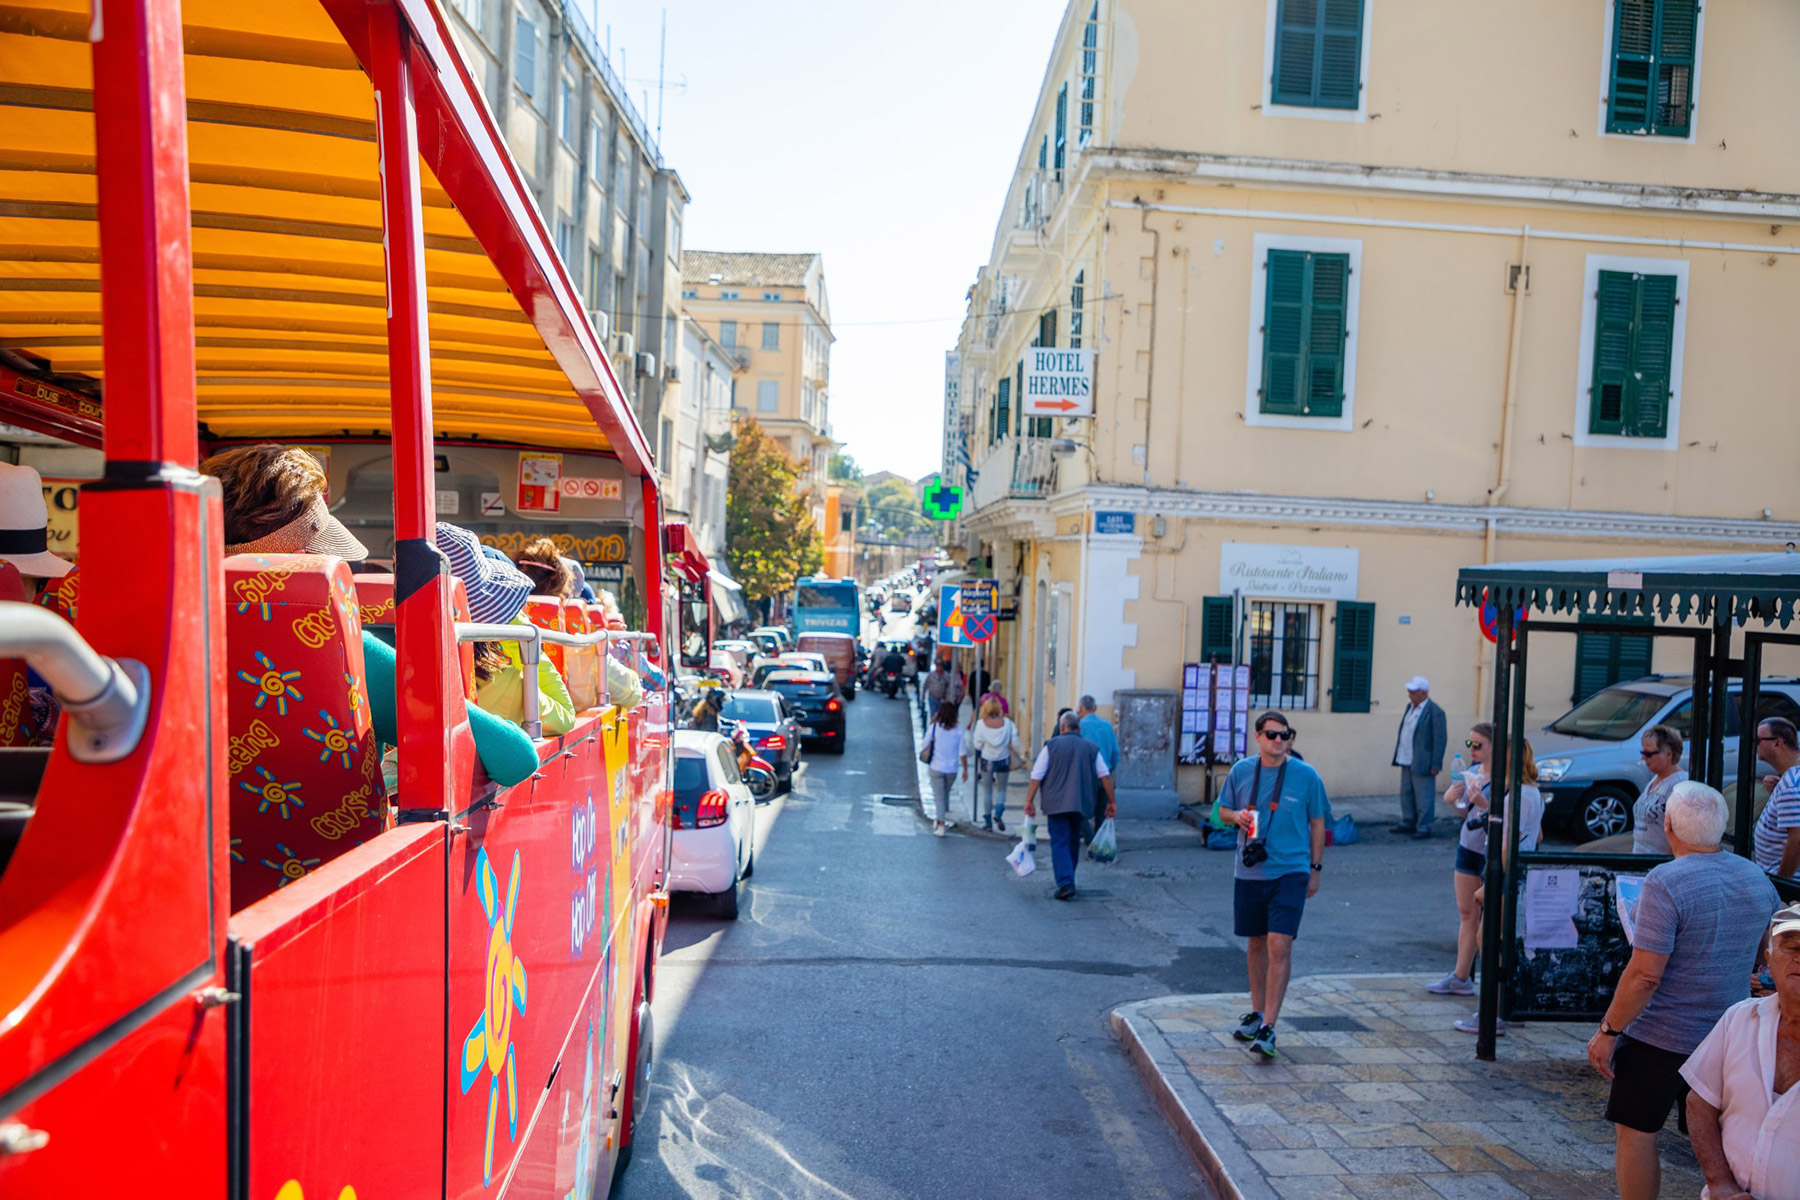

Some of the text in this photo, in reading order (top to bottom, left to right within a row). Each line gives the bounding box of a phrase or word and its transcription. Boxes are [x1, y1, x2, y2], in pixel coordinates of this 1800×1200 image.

[1035, 352, 1084, 372] HOTEL
[1029, 375, 1089, 397] HERMES
[1296, 565, 1349, 582] Italiano
[571, 790, 596, 873] Hop On
[571, 866, 597, 958] Hop Off
